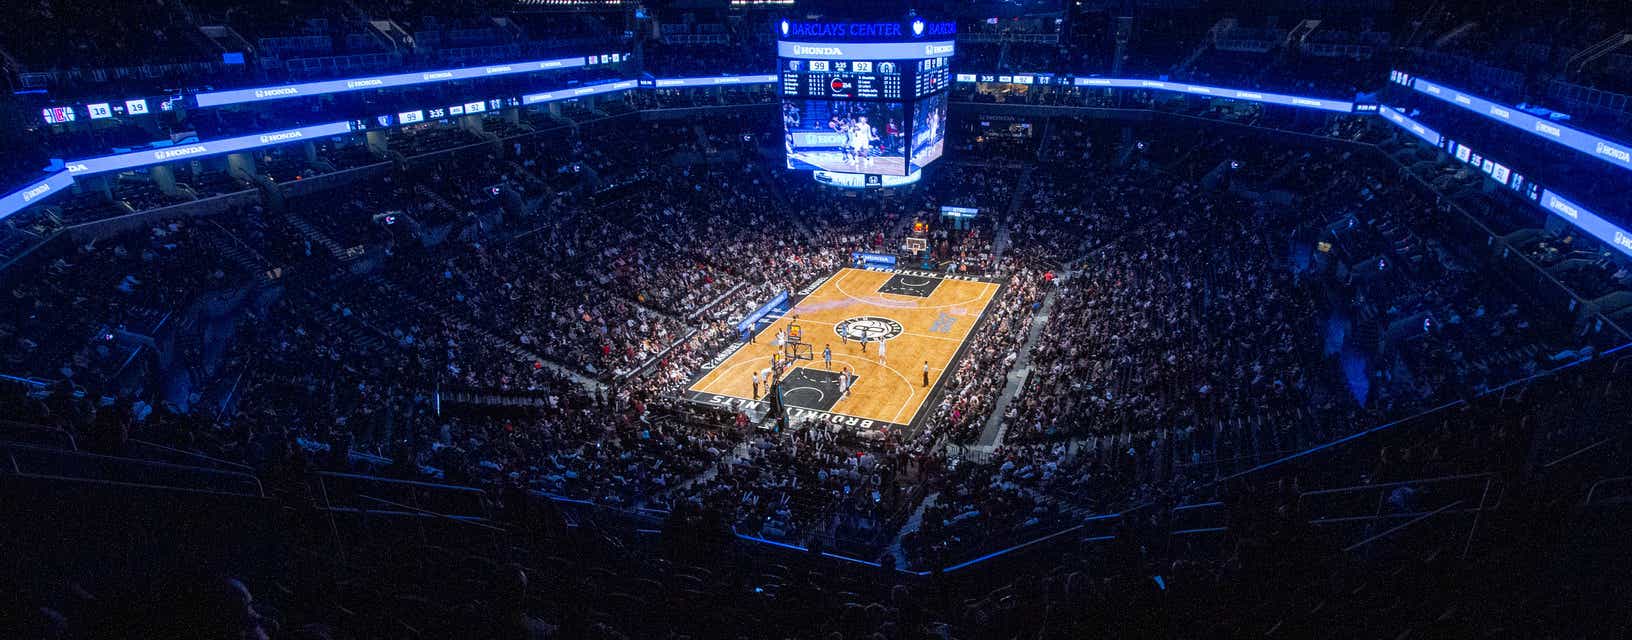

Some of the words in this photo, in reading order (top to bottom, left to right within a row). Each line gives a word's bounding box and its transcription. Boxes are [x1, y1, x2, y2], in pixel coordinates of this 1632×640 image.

[792, 22, 846, 35] BARCLAYS
[850, 23, 902, 36] CENTER
[801, 47, 843, 56] HONDA
[814, 61, 825, 70] 99
[856, 62, 868, 71] 92
[354, 79, 383, 88] HONDA
[264, 87, 298, 97] HONDA
[94, 107, 106, 116] 18
[132, 103, 144, 112] 19
[406, 113, 418, 122] 99
[429, 108, 444, 119] 3:35
[269, 131, 302, 142] HONDA
[165, 145, 208, 158] HONDA
[1603, 143, 1631, 163] HONDA
[864, 254, 889, 263] HONDA
[866, 266, 937, 278] BROOKLYN
[945, 274, 980, 282] NETS
